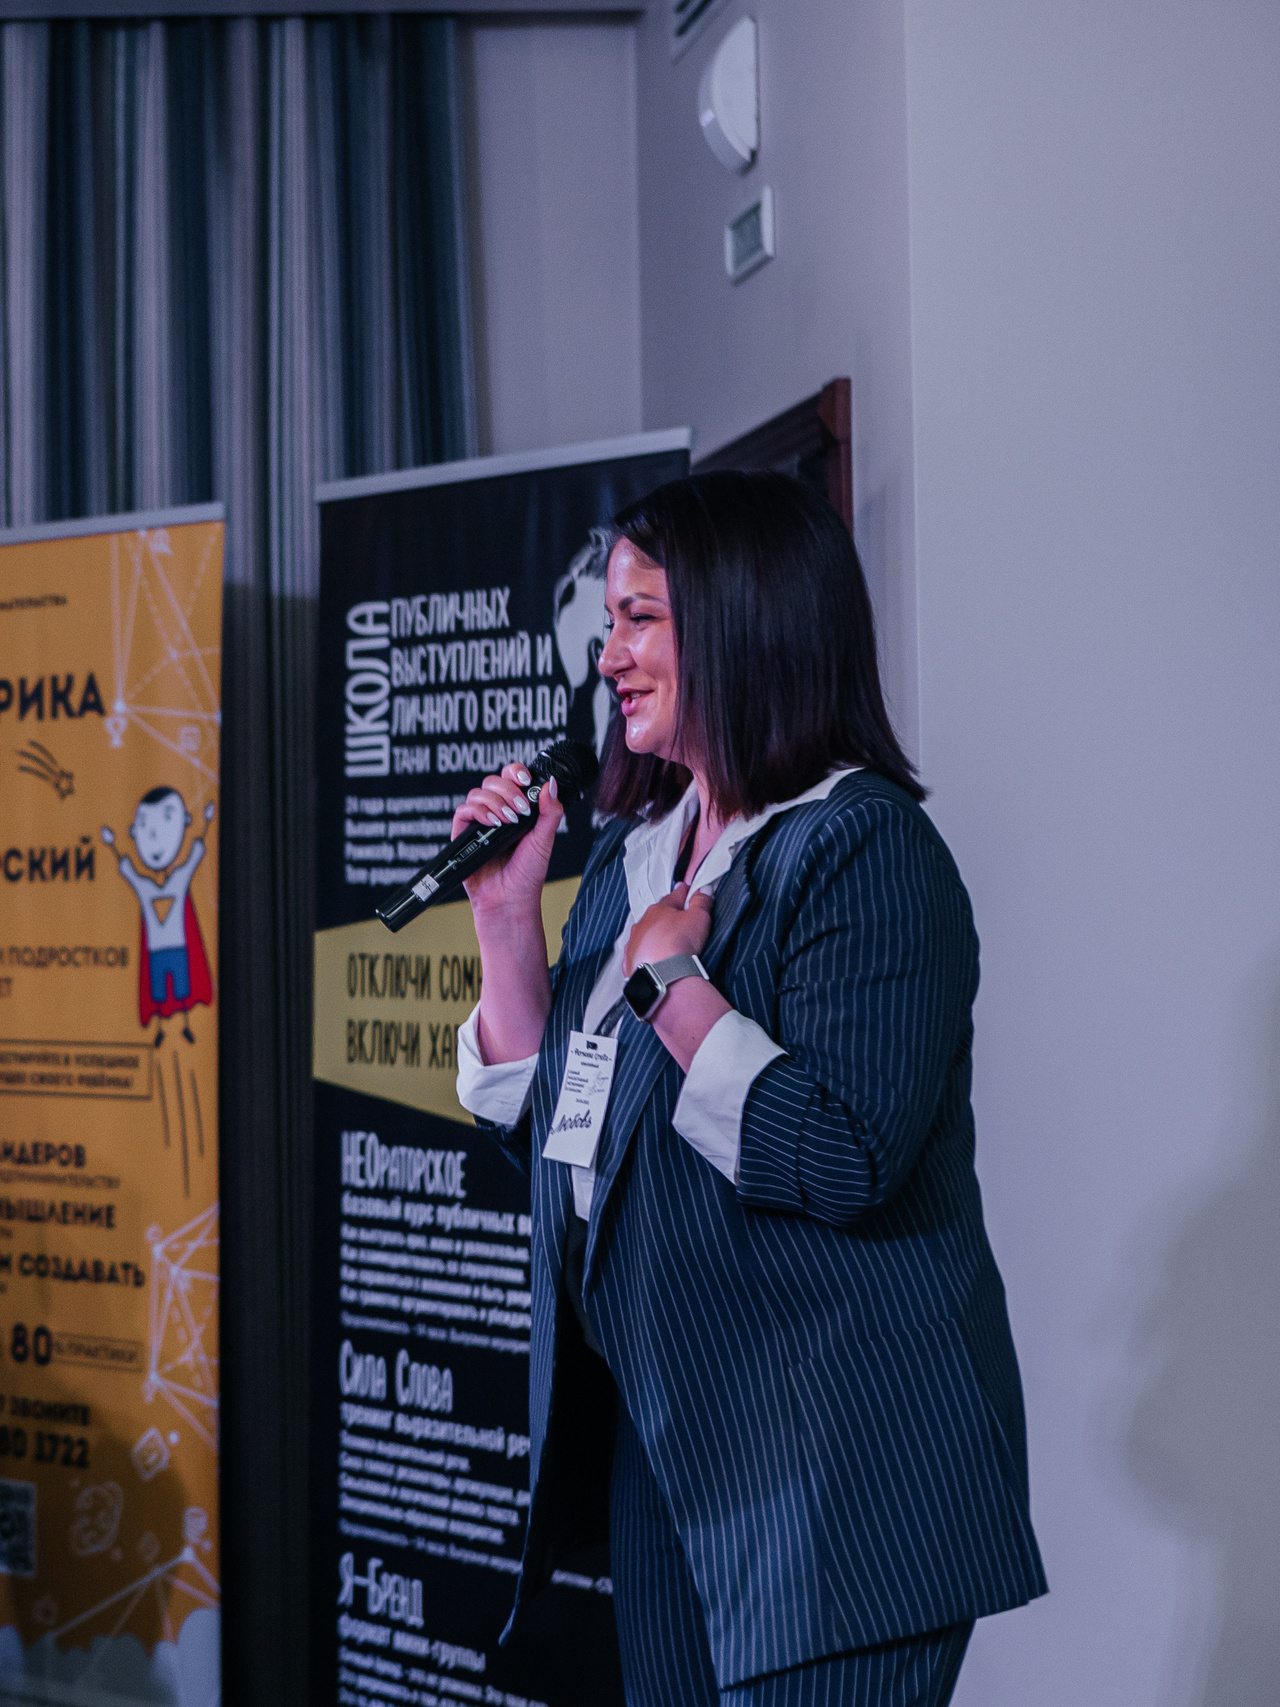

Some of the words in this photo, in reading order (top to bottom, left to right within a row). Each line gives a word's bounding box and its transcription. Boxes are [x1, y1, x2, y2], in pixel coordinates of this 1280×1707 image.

[390, 586, 510, 639] ПУБЛИЧНЫХ
[391, 630, 531, 688] ВЫСТУПЛЕНИЙ
[536, 633, 553, 676] И
[344, 600, 391, 777] ШКОЛА
[392, 690, 480, 736] ЛИЧНОГО
[483, 684, 568, 732] БРЕНДА
[8, 946, 129, 969] ПОДРОСТКОВ
[347, 952, 431, 1000] ОТКЛЮЧИ
[346, 1018, 420, 1067] ВКЛЮЧИ
[19, 1253, 147, 1288] СОЗДАВАТЬ
[11, 1322, 53, 1367] 80
[34, 1430, 91, 1469] 1722
